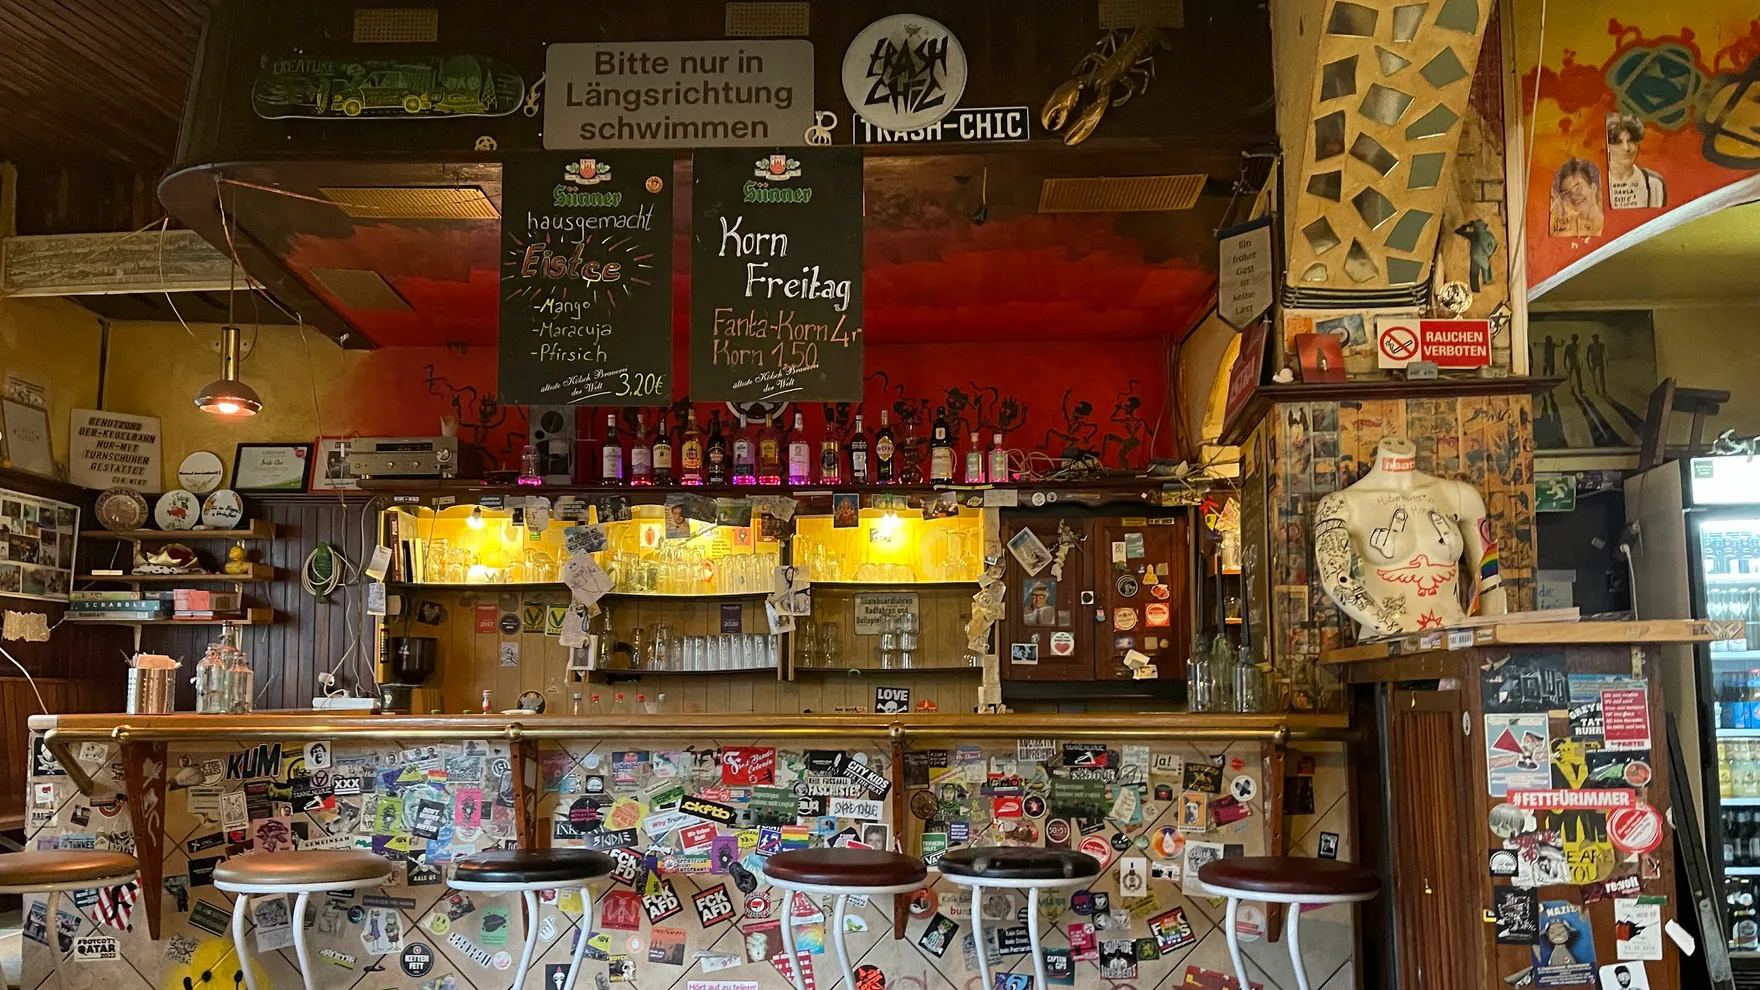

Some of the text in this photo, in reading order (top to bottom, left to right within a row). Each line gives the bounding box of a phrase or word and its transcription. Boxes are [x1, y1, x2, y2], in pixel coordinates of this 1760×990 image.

[595, 49, 763, 76] Bitte nur in
[566, 81, 793, 112] Längsrichtung
[579, 115, 769, 140] schwimmen
[553, 184, 622, 207] Sünner
[743, 180, 812, 203] Sünner
[528, 203, 655, 243] hausgemacht
[718, 216, 788, 257] Korn
[745, 261, 852, 312] Freitag
[713, 307, 828, 341] Fanta-Korn
[1425, 331, 1483, 343] RAUCHEN
[713, 339, 764, 366] Korn
[1423, 345, 1487, 357] VERBOTEN
[562, 374, 591, 387] Kölsch
[593, 366, 628, 380] Brauerei
[754, 371, 783, 384] Kölsch
[763, 378, 795, 393] der Welt
[571, 382, 604, 397] der Welt
[88, 417, 142, 431] BENUTZUNG
[96, 440, 139, 452] NUR-MIT
[84, 450, 150, 465] TURNSCHUHEN
[91, 462, 145, 475] GESTATTET
[877, 687, 909, 701] LOVE
[226, 742, 282, 780] KUM
[1153, 754, 1172, 768] ja!
[334, 778, 360, 789] XXX
[847, 760, 889, 789] CITY KIDS
[1512, 789, 1630, 806] #FETTFÜRIMMER
[305, 836, 350, 847] GEMEINSAM
[611, 863, 635, 879] FD
[642, 885, 673, 909] FCK
[695, 890, 728, 911] FCK
[649, 896, 678, 919] AFD
[702, 902, 731, 923] AFD
[77, 944, 116, 956] QATAR
[408, 962, 424, 970] FETT
